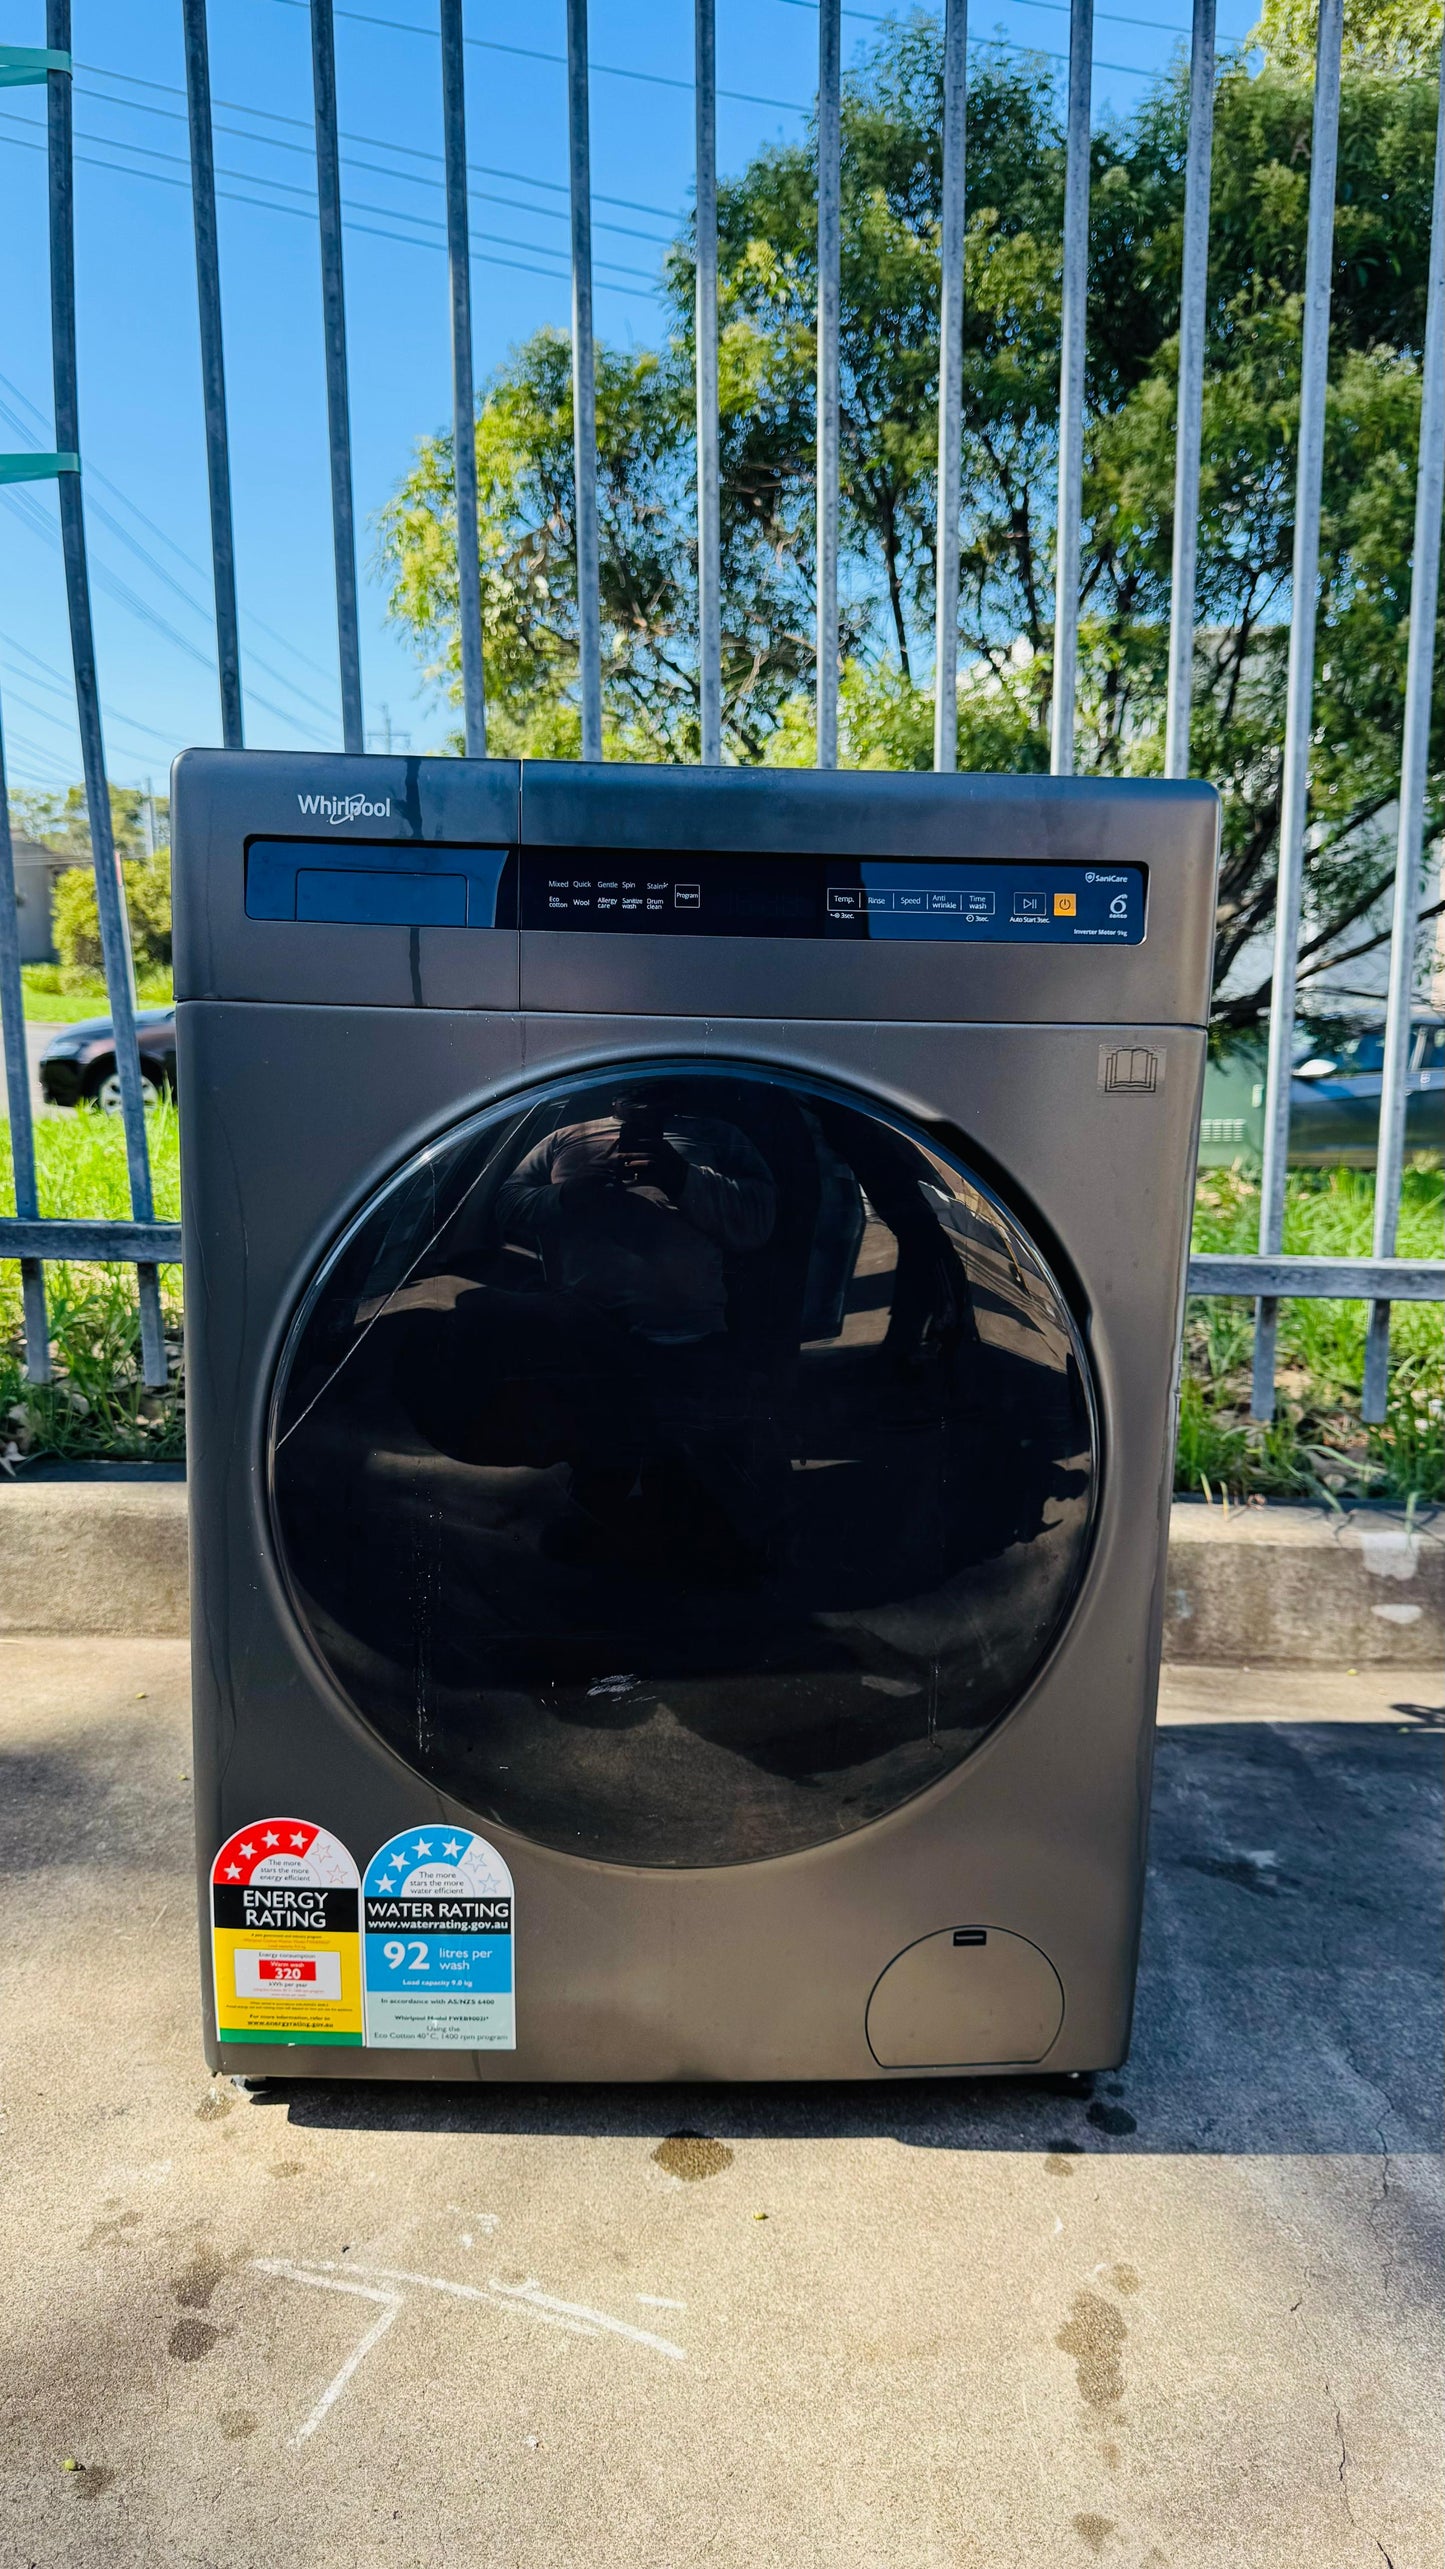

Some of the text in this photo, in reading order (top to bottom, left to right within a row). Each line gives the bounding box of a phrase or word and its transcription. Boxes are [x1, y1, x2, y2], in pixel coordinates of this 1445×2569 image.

[297, 795, 391, 822] Whirlpool
[1096, 874, 1128, 883] SaniCare
[548, 880, 569, 888] Mixed
[573, 881, 592, 889] Quick
[597, 881, 618, 889] Gentle
[622, 881, 636, 890] Spin
[676, 892, 699, 900] Program
[834, 895, 855, 904] Temp.
[573, 898, 590, 906] Wool
[597, 897, 618, 905] Allergy
[900, 897, 921, 906] Speed
[932, 901, 956, 909] wrinkle
[242, 1890, 329, 1909] ENERGY
[367, 1902, 510, 1918] WATER RATING
[246, 1909, 327, 1928] RATING
[368, 1919, 508, 1932] www.waterrating.gov.au
[382, 1941, 493, 1970] 92 litres per
[439, 1960, 470, 1970] wash
[274, 1967, 302, 1980] 320
[421, 1980, 450, 1988] capacity
[463, 1980, 473, 1988] kg
